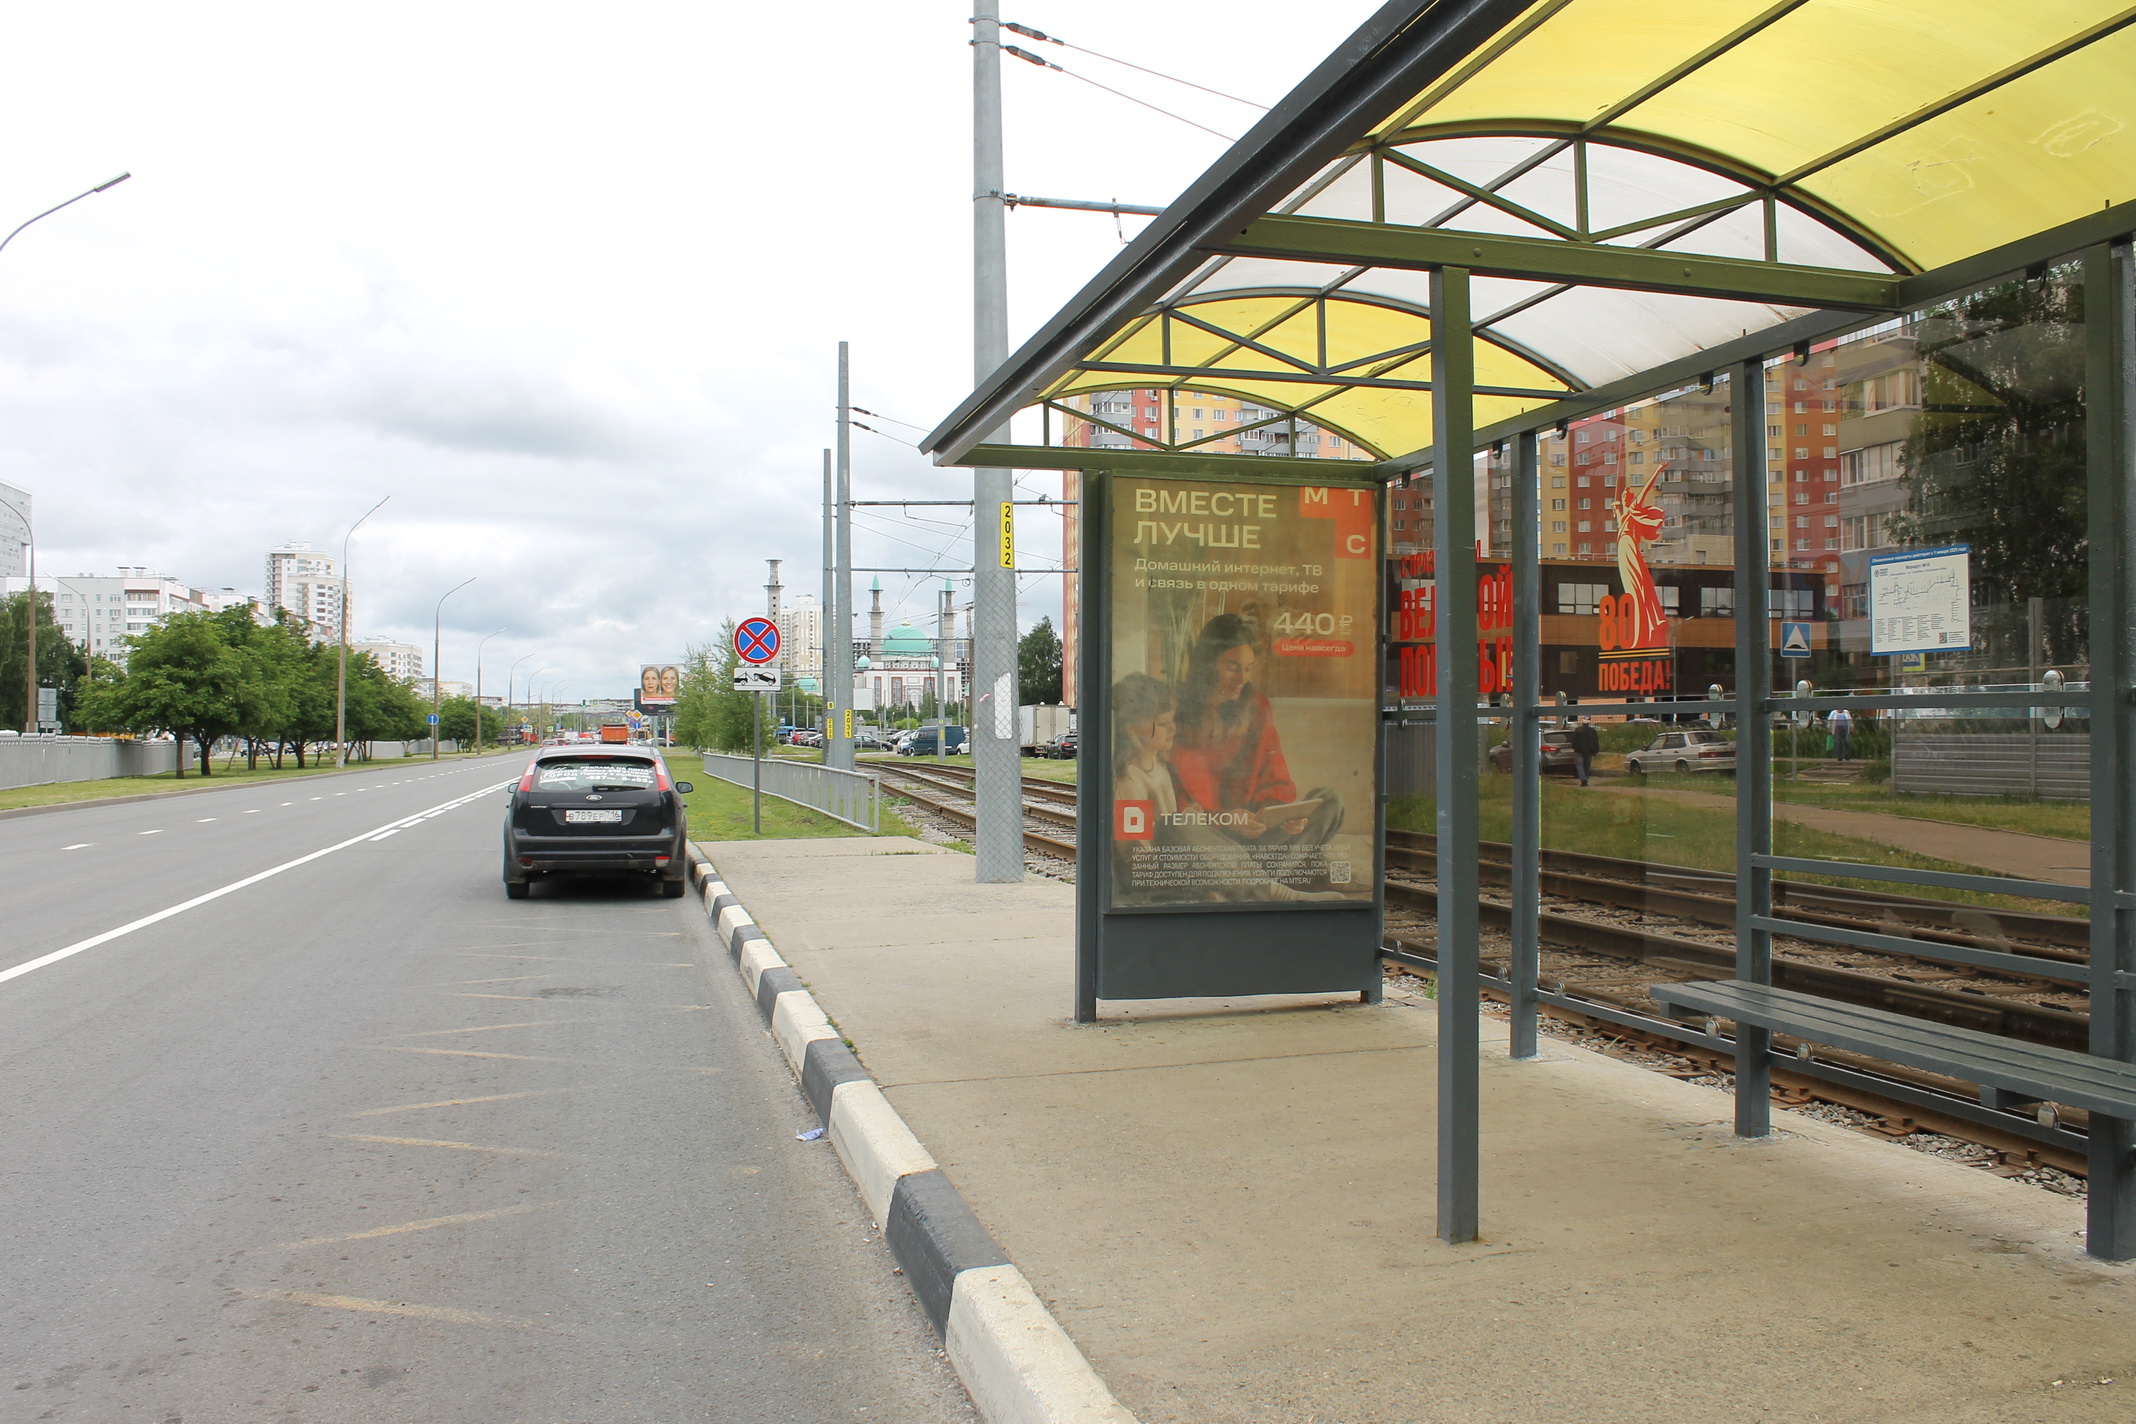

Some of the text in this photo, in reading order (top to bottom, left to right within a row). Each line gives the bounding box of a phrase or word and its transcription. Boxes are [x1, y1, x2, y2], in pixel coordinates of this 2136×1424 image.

[1135, 488, 1277, 518] ВМЕСТЕ
[1004, 504, 1012, 566] 2032
[1133, 521, 1261, 549] ЛУЧШЕ
[1135, 557, 1323, 577] Домашний интернет, ТВ
[1135, 578, 1320, 596] и связь в одном тарифе
[1600, 592, 1636, 650] 80
[1281, 643, 1346, 653] Цена навсегда
[1599, 660, 1671, 696] ПОБЕДА!
[1160, 812, 1249, 826] ТЕЛЕКОМ
[1131, 845, 1161, 853] УКАЗАНА
[1161, 845, 1191, 853] БАЗОВАЯ
[1131, 861, 1159, 870] ЗАННЫЙ
[1154, 871, 1188, 879] ДОСТУПЕН
[1252, 869, 1275, 877] УСЛУГИ
[1276, 869, 1328, 877] ПОДКЛЮЧАЮТСЯ
[1131, 879, 1145, 887] ПРИ
[1146, 878, 1190, 887] ТЕХНИЧЕСКОЙ
[1289, 877, 1312, 885] MTS.RU
